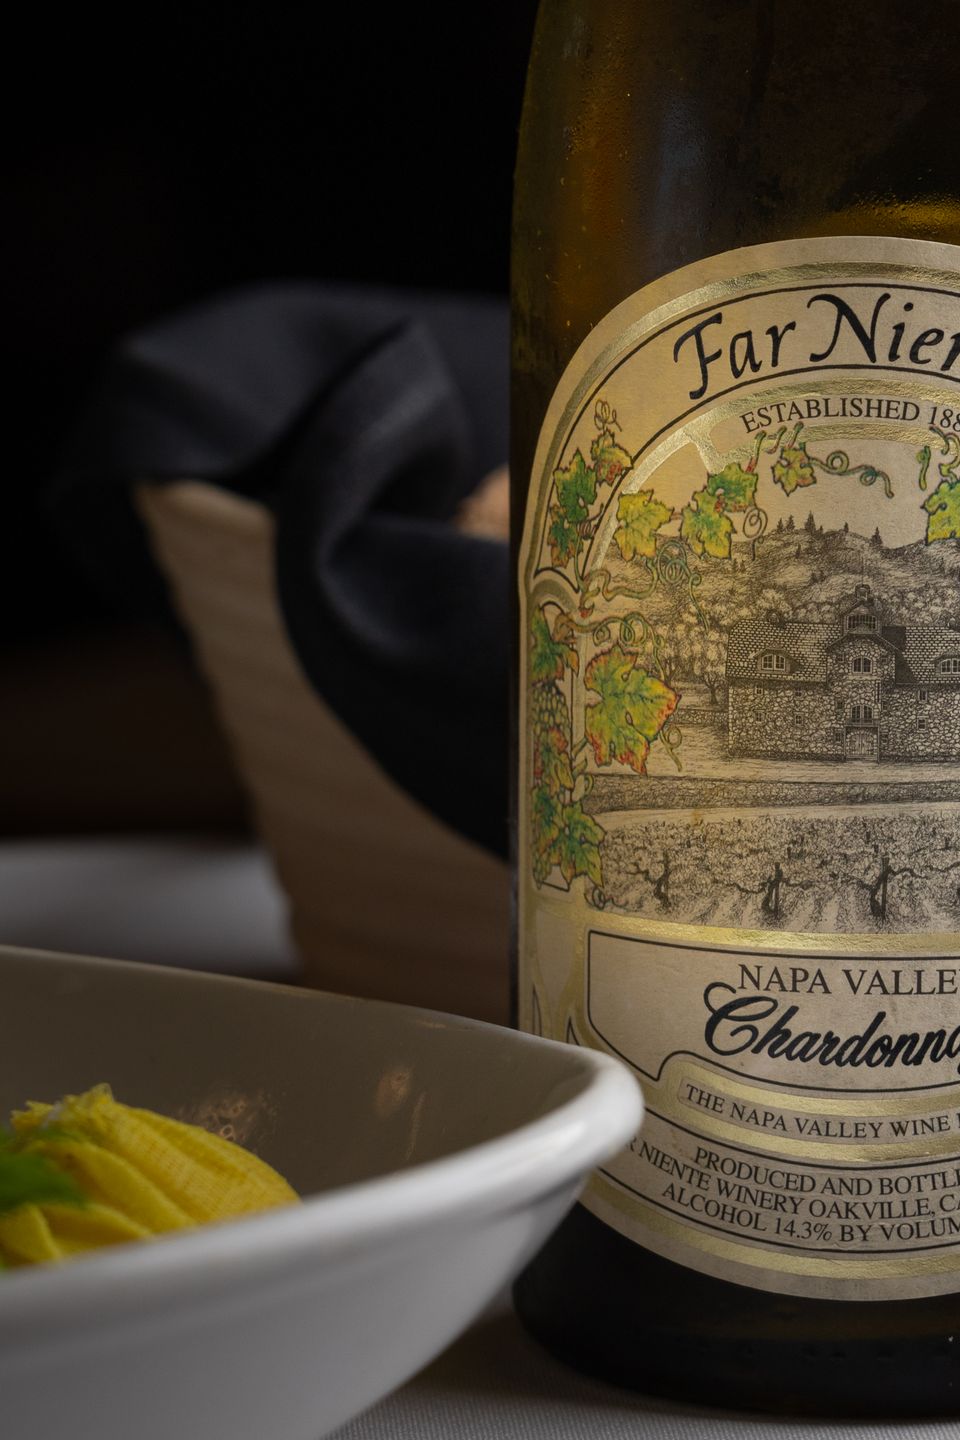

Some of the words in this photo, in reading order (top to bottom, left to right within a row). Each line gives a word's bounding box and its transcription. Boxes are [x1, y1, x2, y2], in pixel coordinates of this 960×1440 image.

[672, 311, 797, 400] Far
[739, 397, 921, 434] ESTABLISHED
[738, 963, 833, 995] NAPA
[686, 1083, 726, 1115] THE
[729, 1101, 789, 1133] NAPA
[794, 1116, 884, 1140] VALLEY
[890, 1115, 952, 1138] WINE
[638, 1139, 713, 1192] NIENTE
[716, 1177, 806, 1216] WINERY
[808, 1197, 936, 1220] OAKVILLE,
[694, 1146, 817, 1193] PRODUCED
[820, 1176, 873, 1197] AND
[661, 1182, 768, 1232] ALCOHOL
[774, 1216, 833, 1242] 14.3%
[839, 1223, 877, 1243] BY
